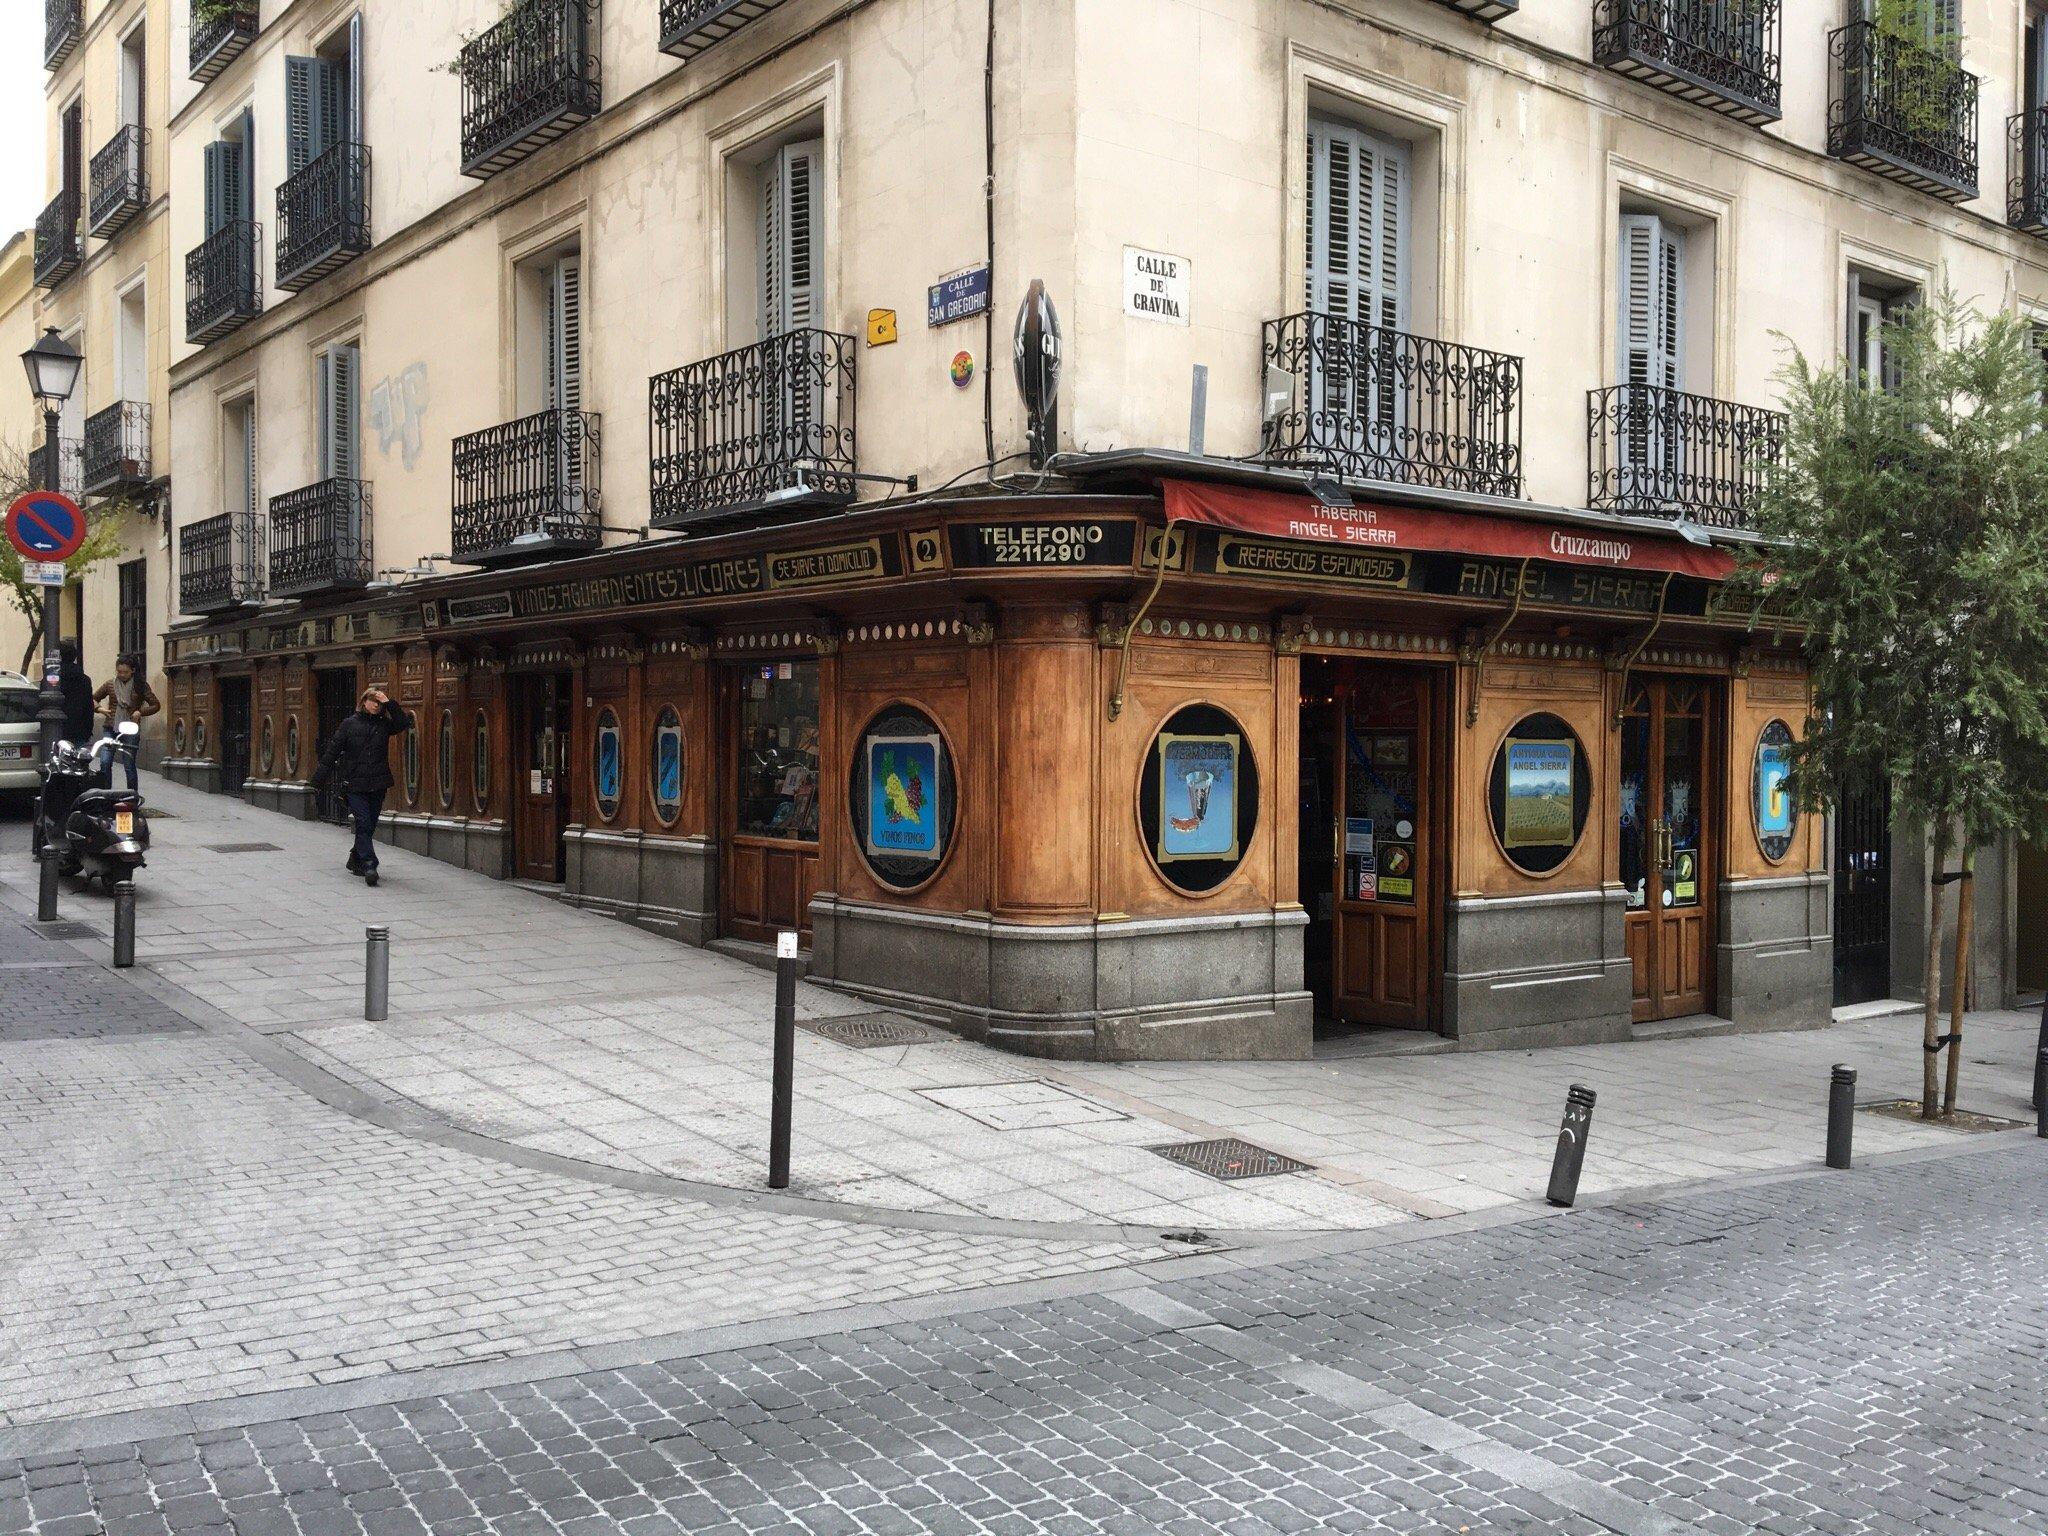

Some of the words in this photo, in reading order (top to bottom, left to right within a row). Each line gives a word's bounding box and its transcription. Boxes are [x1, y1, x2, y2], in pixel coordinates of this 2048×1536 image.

[1137, 255, 1177, 279] CALLE
[948, 275, 976, 293] CALLE
[956, 289, 967, 298] DE
[1149, 278, 1164, 293] DE
[929, 304, 945, 324] SAN
[947, 290, 987, 318] GREGORIO
[1133, 292, 1181, 318] GRAVINA
[1310, 504, 1378, 524] TABERNA
[979, 525, 1103, 545] TELEFONO
[1289, 520, 1339, 539] ANGEL
[1345, 526, 1396, 544] SIERRA
[921, 540, 932, 561] 2
[995, 544, 1086, 562] 2211290
[1550, 530, 1631, 564] Cruzcampo
[778, 560, 789, 578] SE
[818, 556, 826, 574] A
[828, 550, 870, 575] DOMICILIO
[1238, 546, 1317, 572] REFRESCOS
[1321, 553, 1395, 579] ESPUMOSOS
[1459, 562, 1554, 600] ANGEL
[1513, 761, 1538, 770] ANGEL
[1539, 761, 1567, 770] SIERRA
